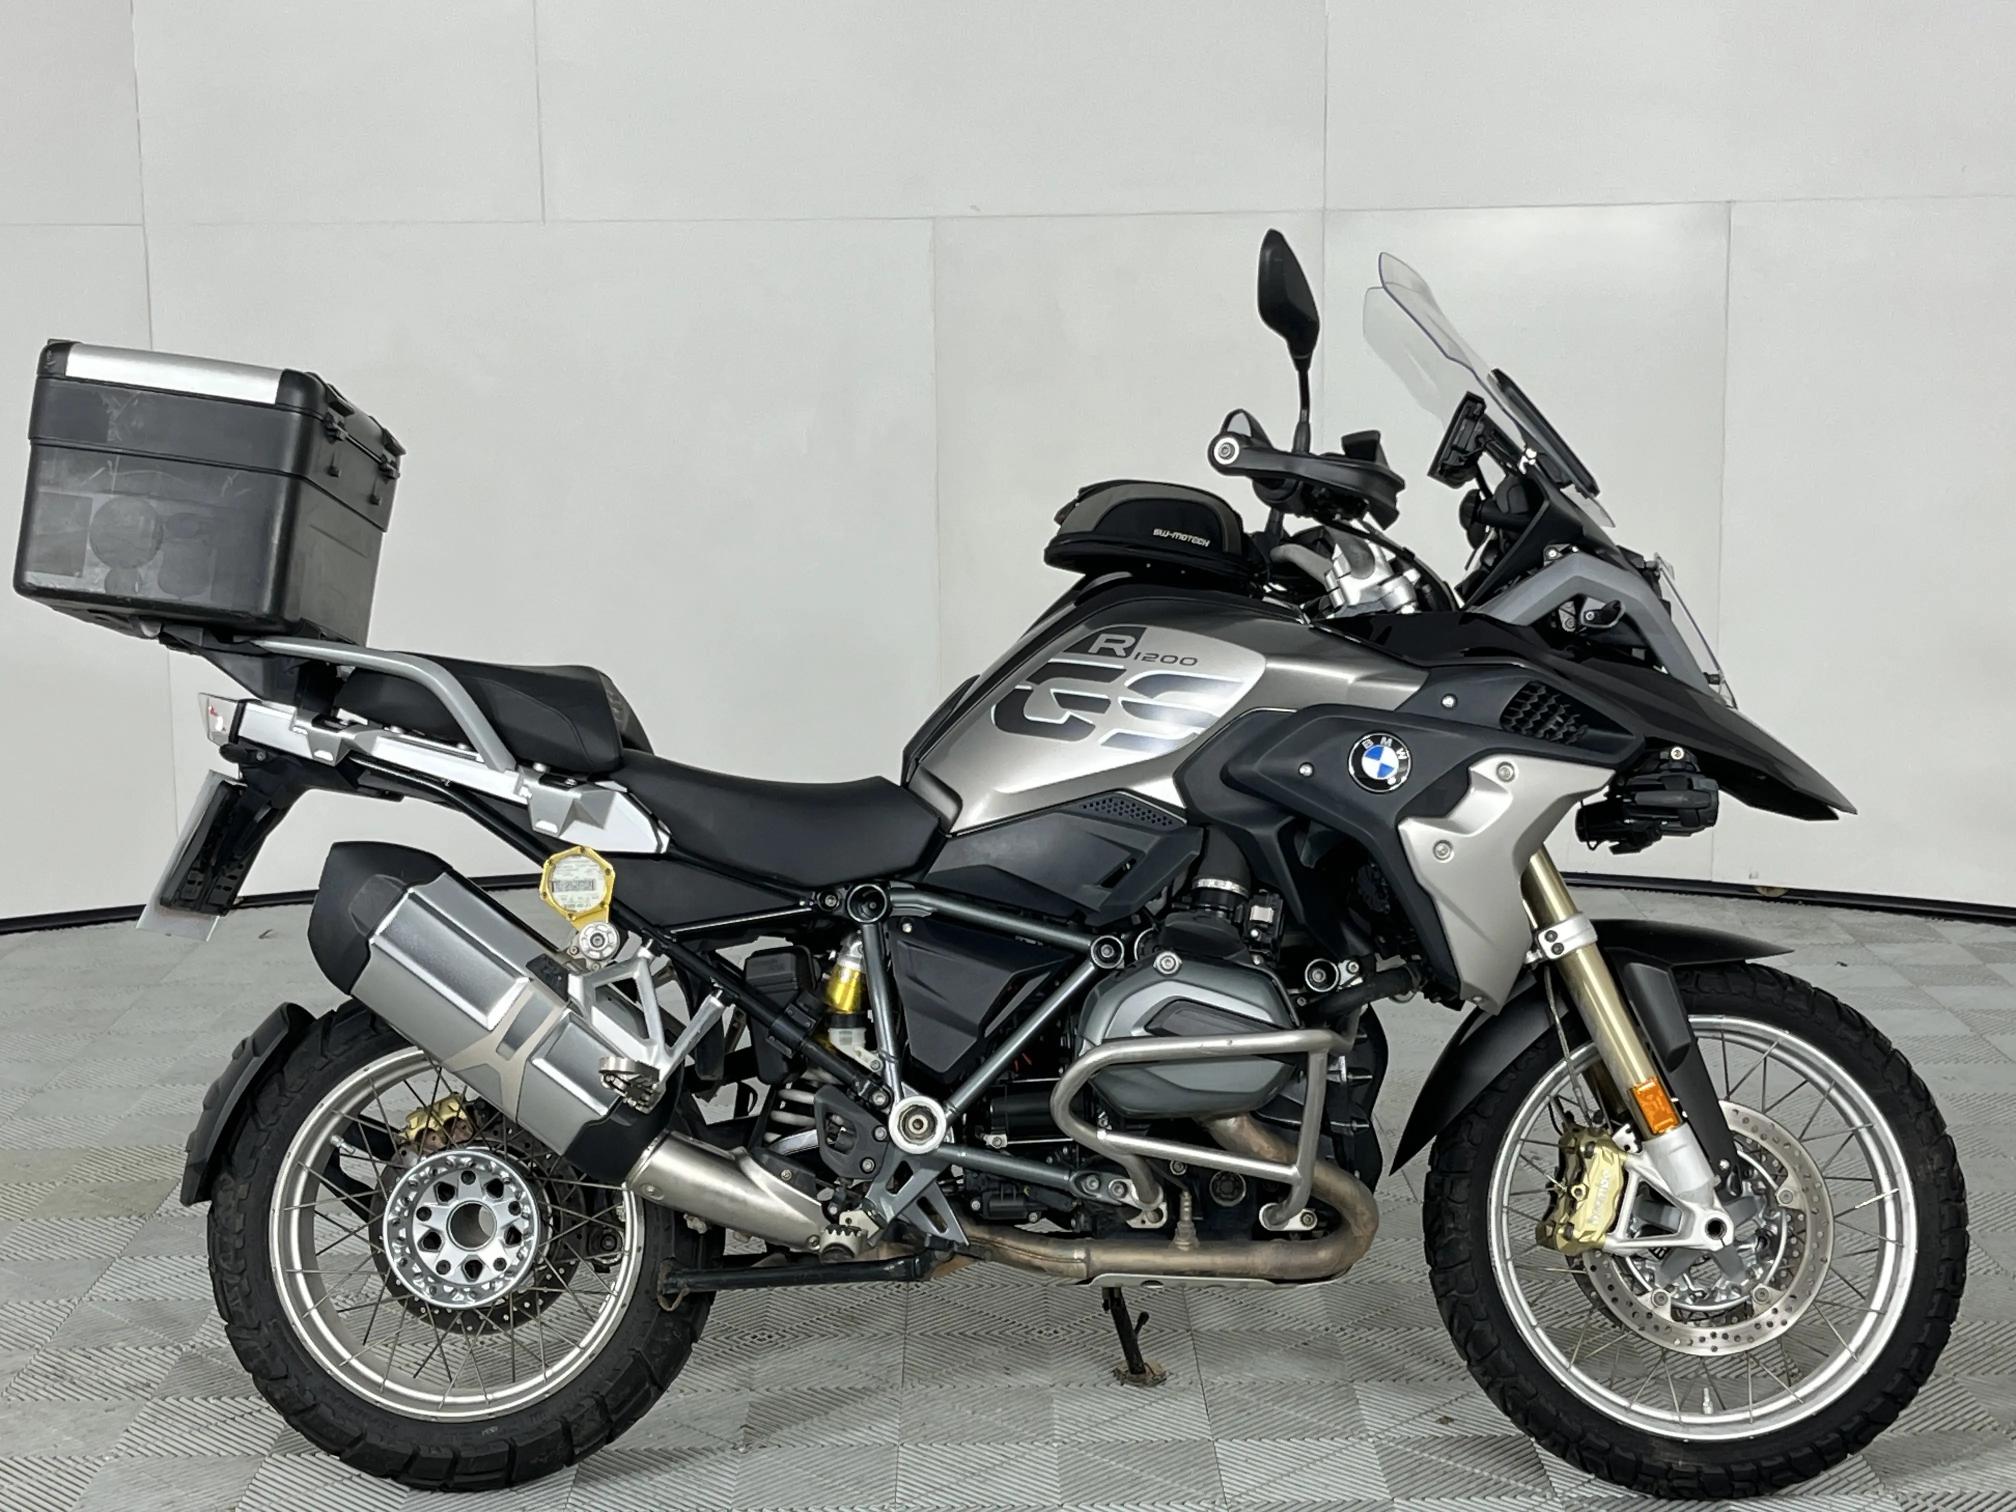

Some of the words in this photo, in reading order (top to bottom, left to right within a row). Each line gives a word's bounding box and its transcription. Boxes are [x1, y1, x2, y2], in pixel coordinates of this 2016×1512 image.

[1153, 528, 1210, 547] SW-MOTECH
[1088, 633, 1136, 657] R
[1134, 652, 1198, 666] 1200
[1361, 736, 1408, 760] BMW
